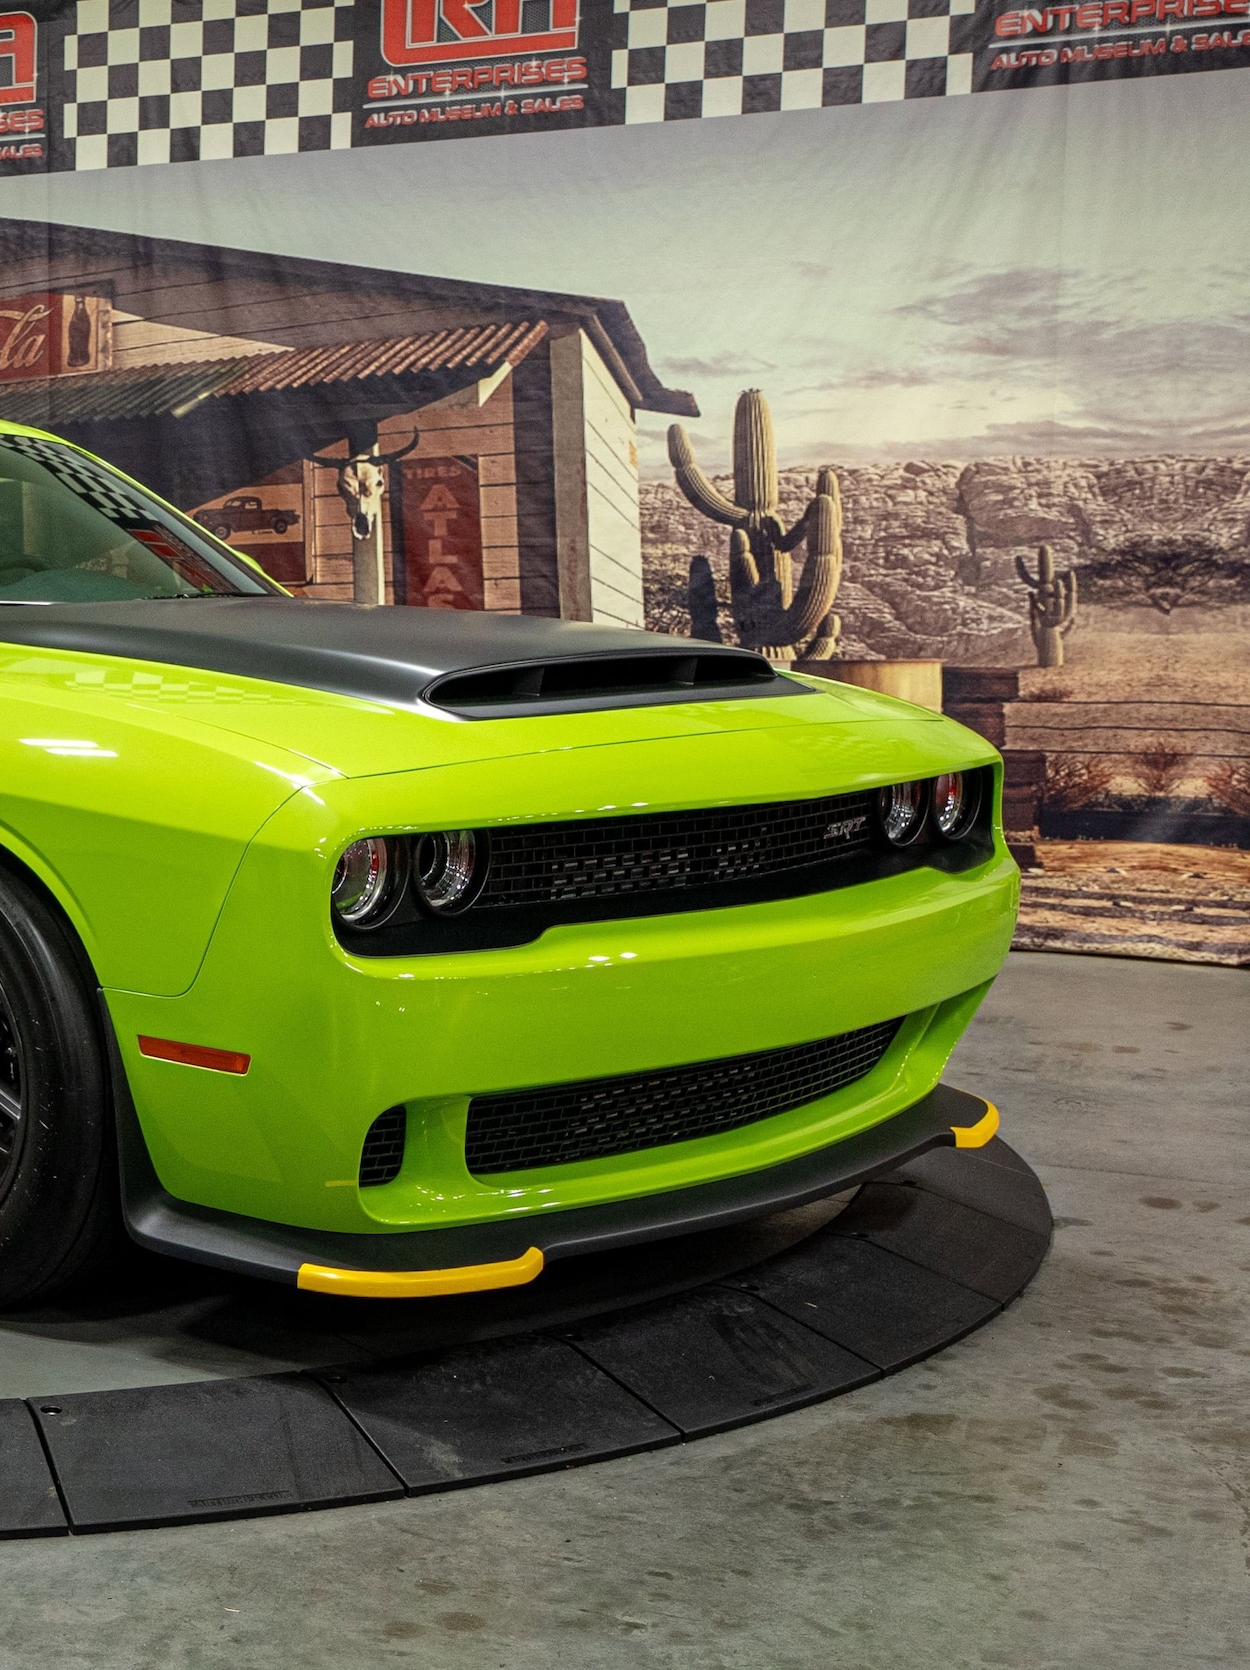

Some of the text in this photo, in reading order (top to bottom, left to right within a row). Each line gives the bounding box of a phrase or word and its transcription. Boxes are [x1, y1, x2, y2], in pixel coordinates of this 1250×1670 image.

[991, 49, 1057, 70] AUTO
[1060, 38, 1166, 63] MUSEUM
[1170, 35, 1188, 53] &
[367, 56, 588, 99] ENTERPRISES
[364, 95, 585, 128] AUTO MUSEUM & SALES
